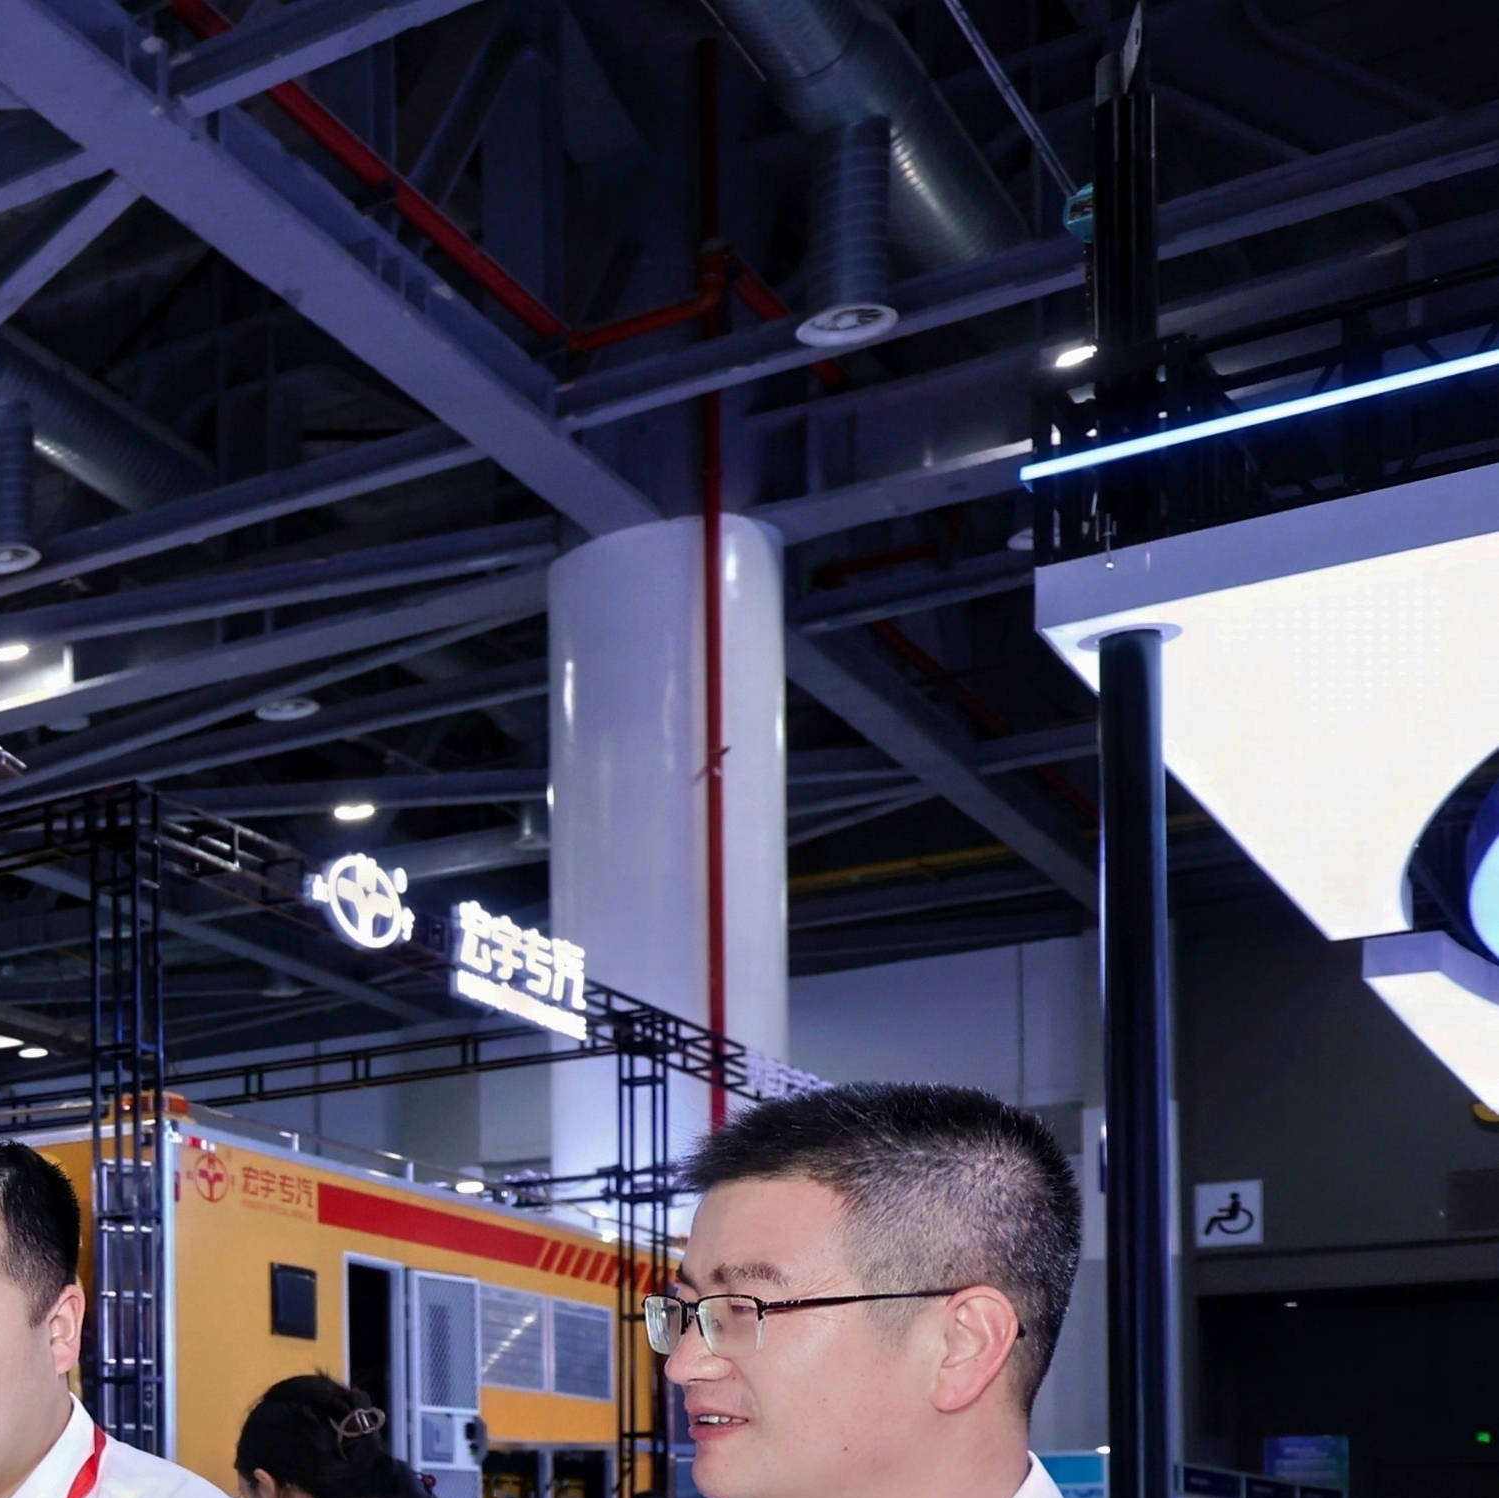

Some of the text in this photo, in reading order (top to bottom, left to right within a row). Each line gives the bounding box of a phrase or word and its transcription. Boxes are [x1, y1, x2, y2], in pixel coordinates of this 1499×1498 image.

[458, 900, 588, 1010] 宏宇专汽
[242, 1165, 314, 1208] 宏宇专汽
